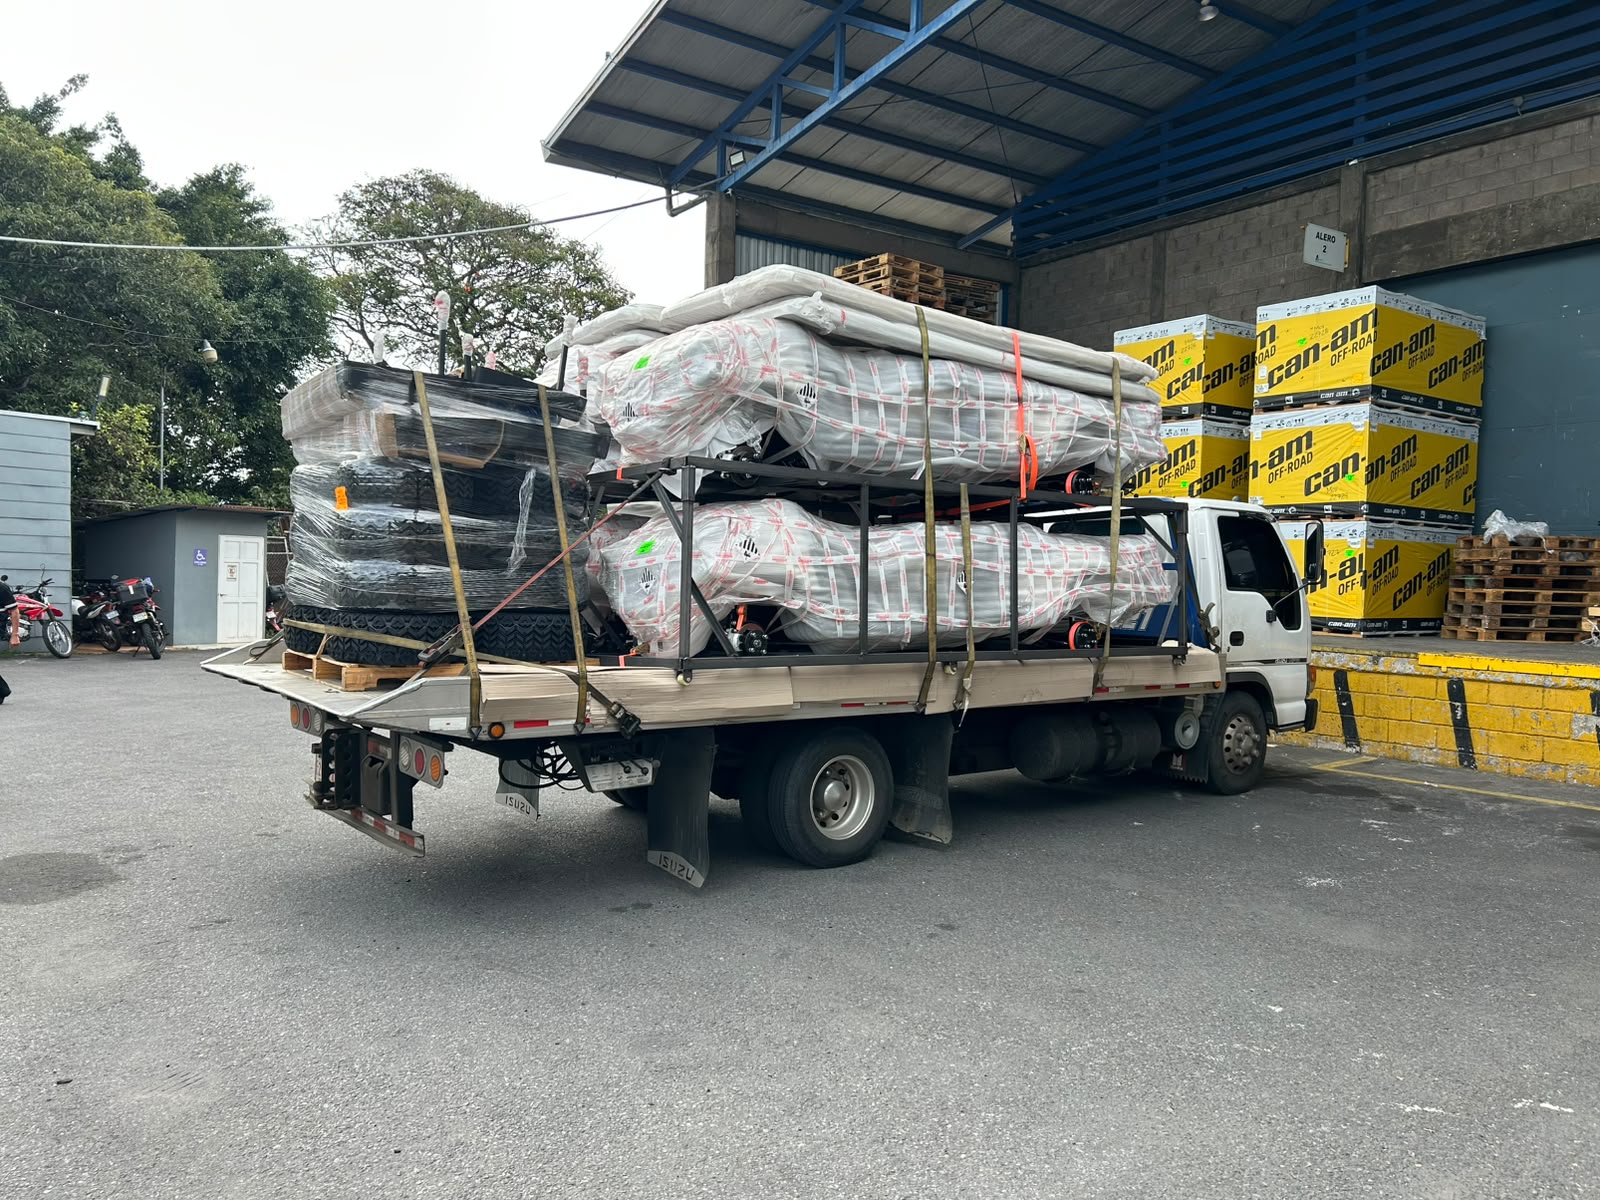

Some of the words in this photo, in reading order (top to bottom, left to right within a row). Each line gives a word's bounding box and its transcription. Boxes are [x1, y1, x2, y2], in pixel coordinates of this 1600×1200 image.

[1315, 231, 1336, 244] ALERO
[1322, 245, 1327, 253] 2
[1268, 308, 1378, 389] can-am
[1330, 330, 1378, 367] OFF-ROAD
[1370, 323, 1435, 377] can-am
[1408, 345, 1435, 369] OFF-ROAD
[1462, 361, 1483, 382] OFF-ROA
[1248, 430, 1313, 480] n-am
[1268, 451, 1313, 484] OFF-ROAD
[1365, 433, 1417, 485] an-am
[1391, 455, 1417, 482] OFF-ROAD
[1158, 459, 1196, 488] OFF-ROAD
[1304, 452, 1366, 497] can-
[1411, 443, 1469, 500] can-am
[1445, 463, 1469, 489] OFF-ROAD
[1372, 566, 1398, 596] OFF-ROAD
[1392, 548, 1450, 611] can-am
[505, 795, 531, 815] ISUZU
[659, 853, 695, 881] ISUZU
